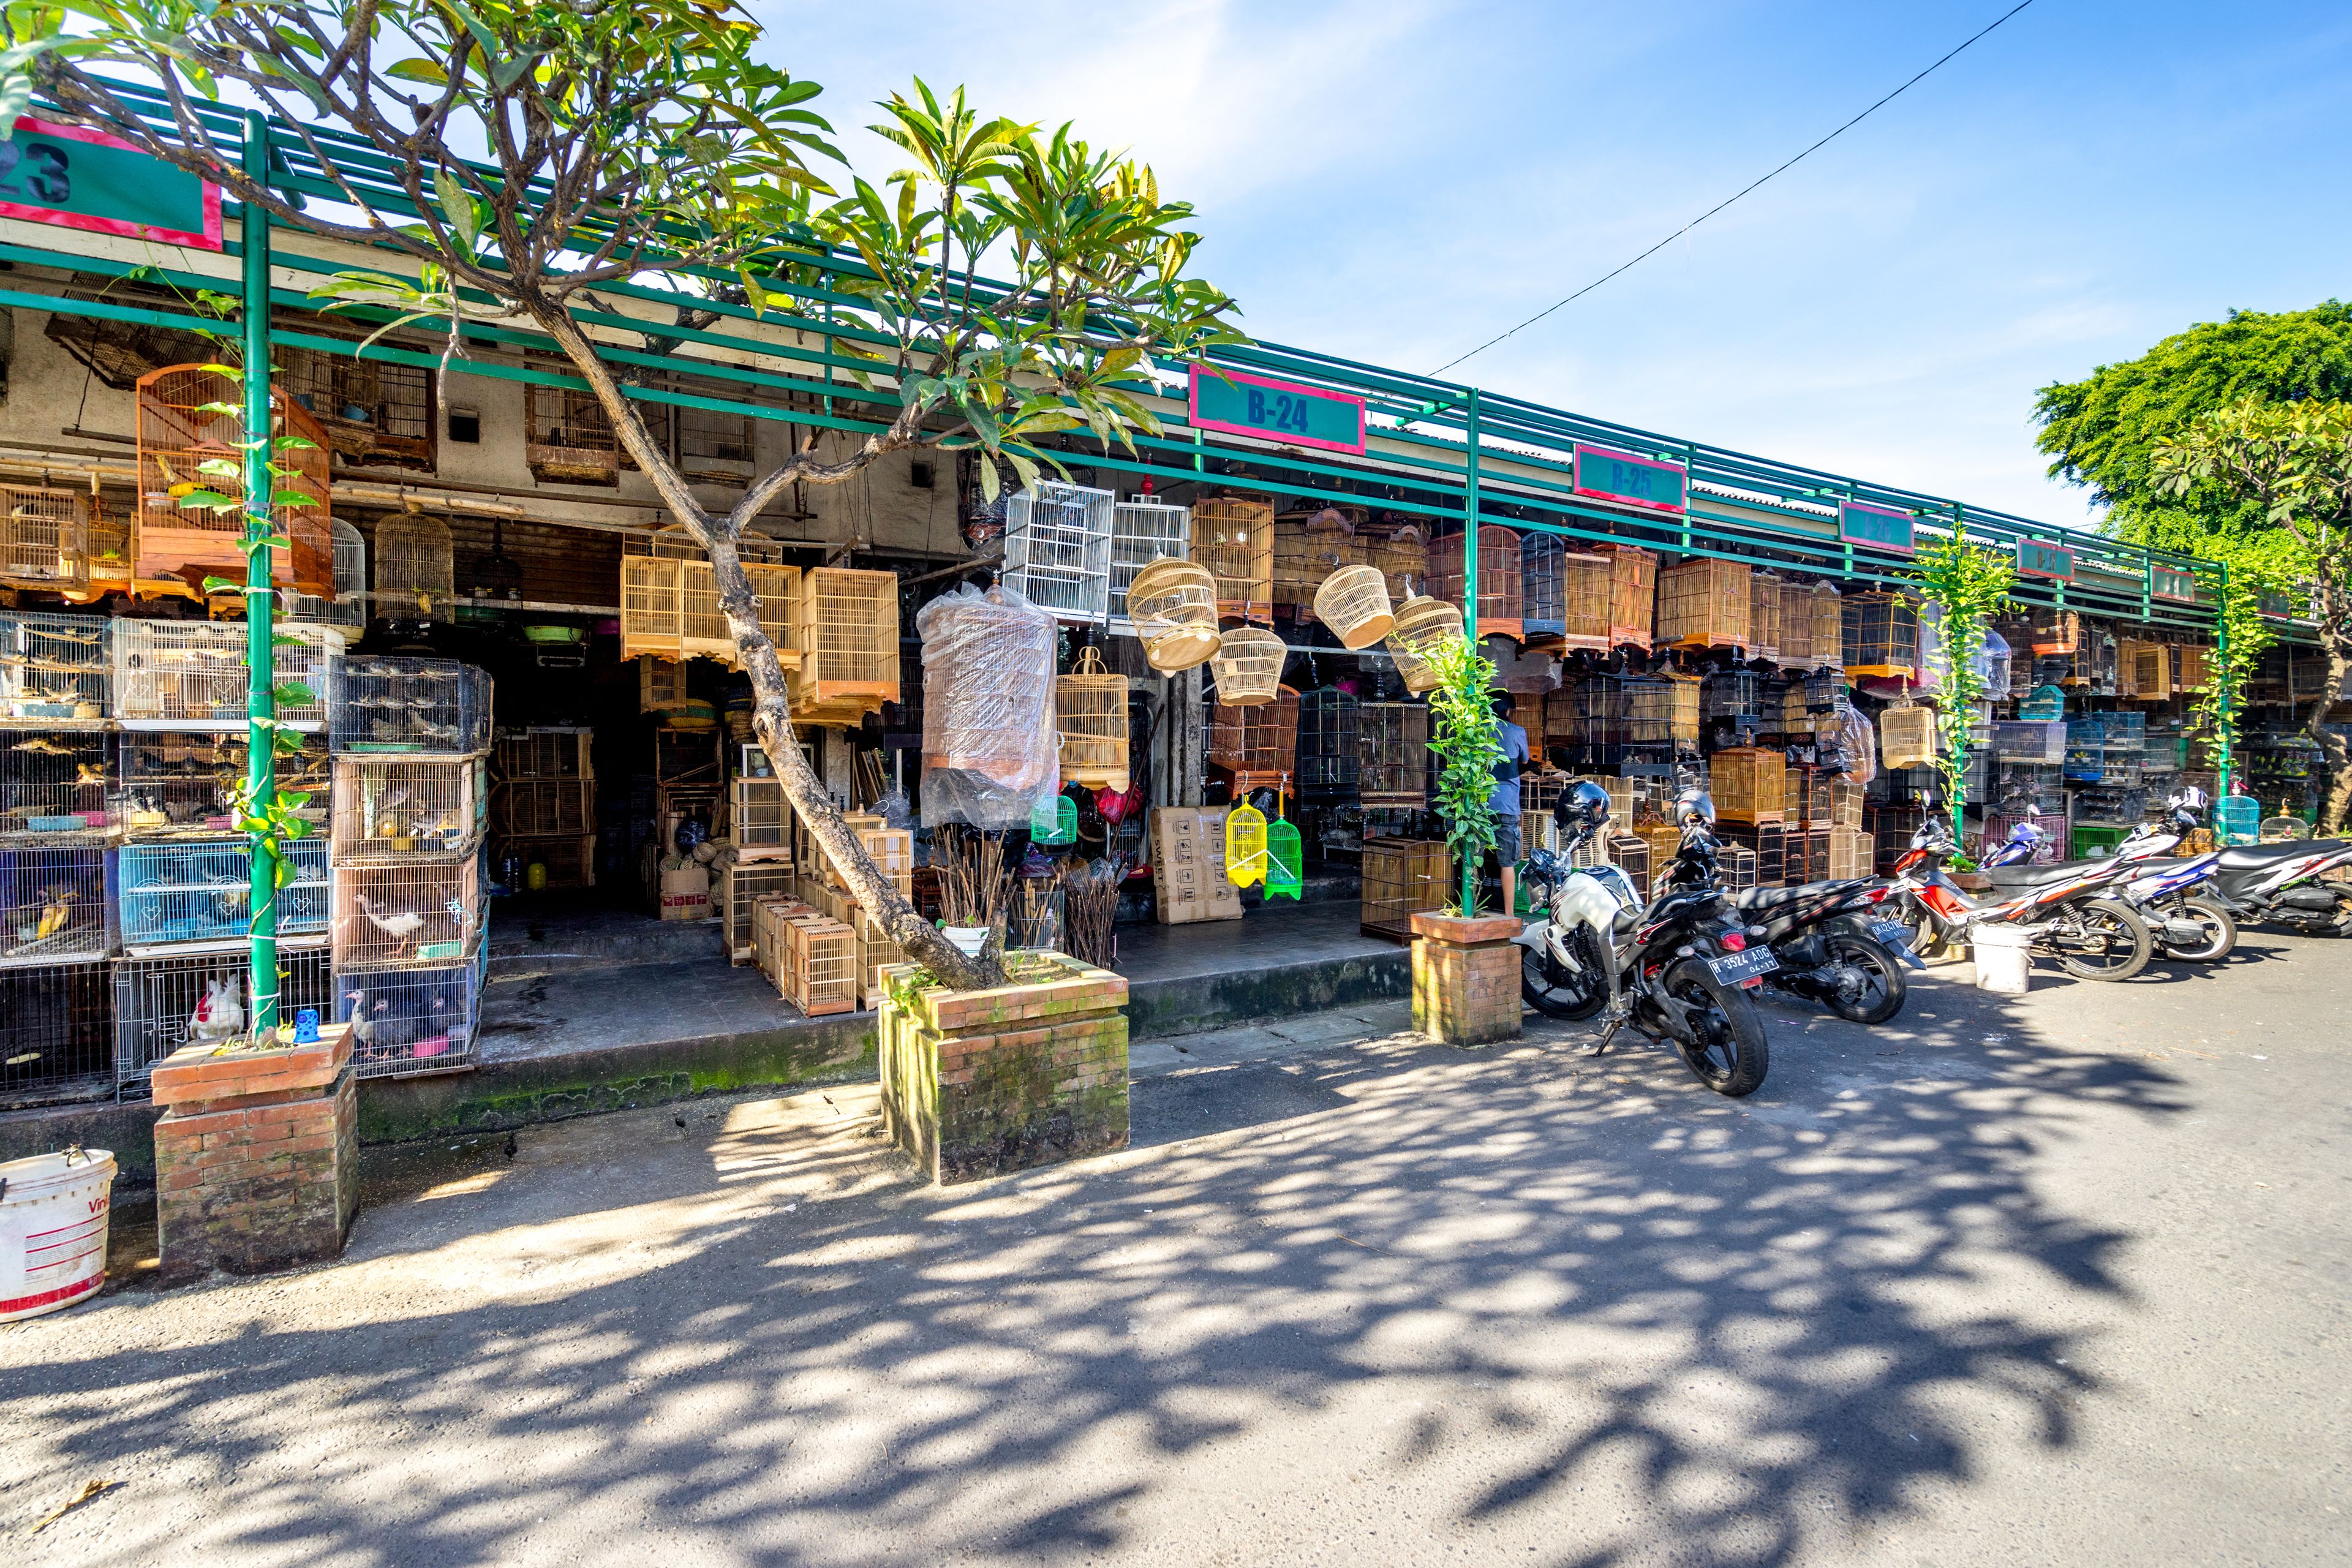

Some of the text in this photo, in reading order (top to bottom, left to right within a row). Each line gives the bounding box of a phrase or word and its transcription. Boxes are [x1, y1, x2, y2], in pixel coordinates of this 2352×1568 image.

[1248, 389, 1308, 432] B-24
[1612, 462, 1651, 497] B-25
[1864, 515, 1891, 540] B-26
[1155, 839, 1163, 882] SWEET
[1711, 948, 1770, 974] H 3524 ADG
